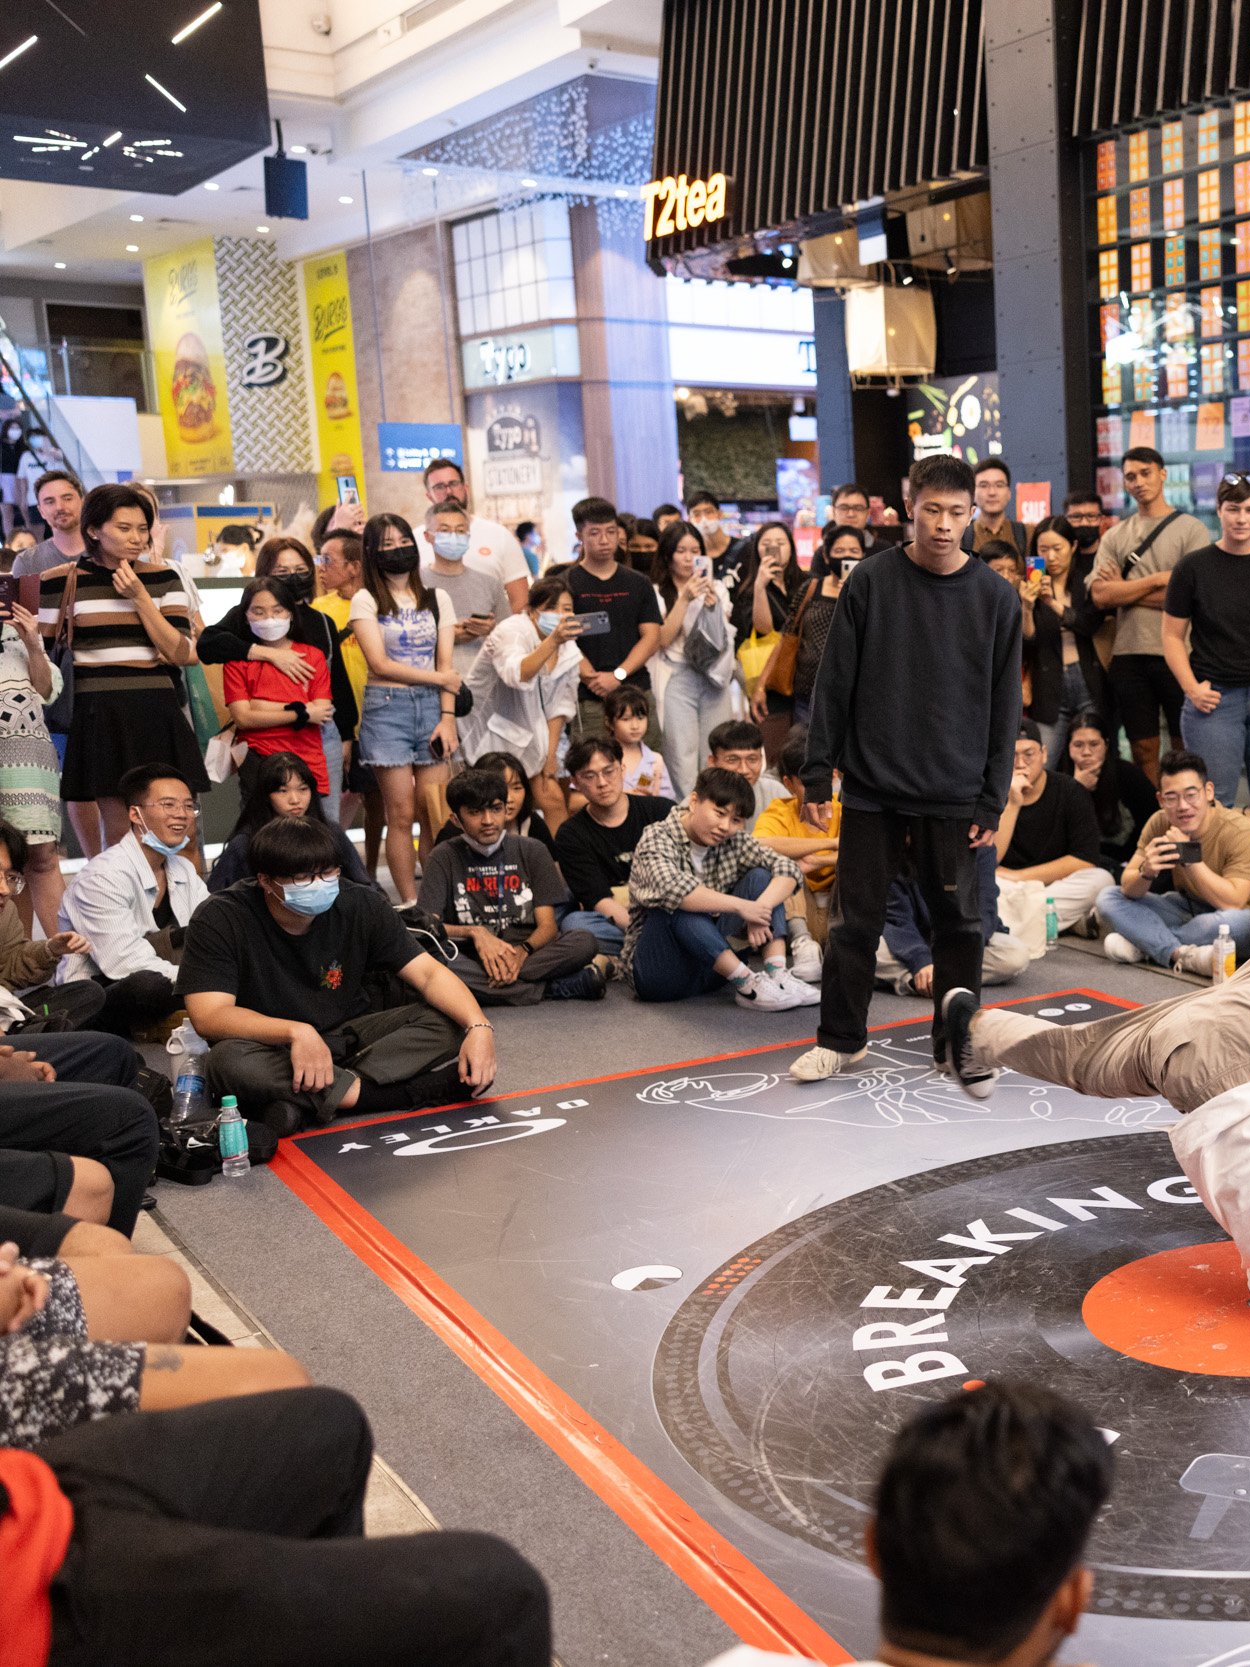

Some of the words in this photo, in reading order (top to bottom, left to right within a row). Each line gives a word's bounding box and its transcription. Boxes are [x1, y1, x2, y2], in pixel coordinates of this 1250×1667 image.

[640, 172, 727, 241] T2tea
[479, 339, 531, 386] Typo
[487, 463, 538, 489] STATIONERY
[337, 1098, 590, 1155] OAKLEY
[852, 1175, 1204, 1393] BREAKING
